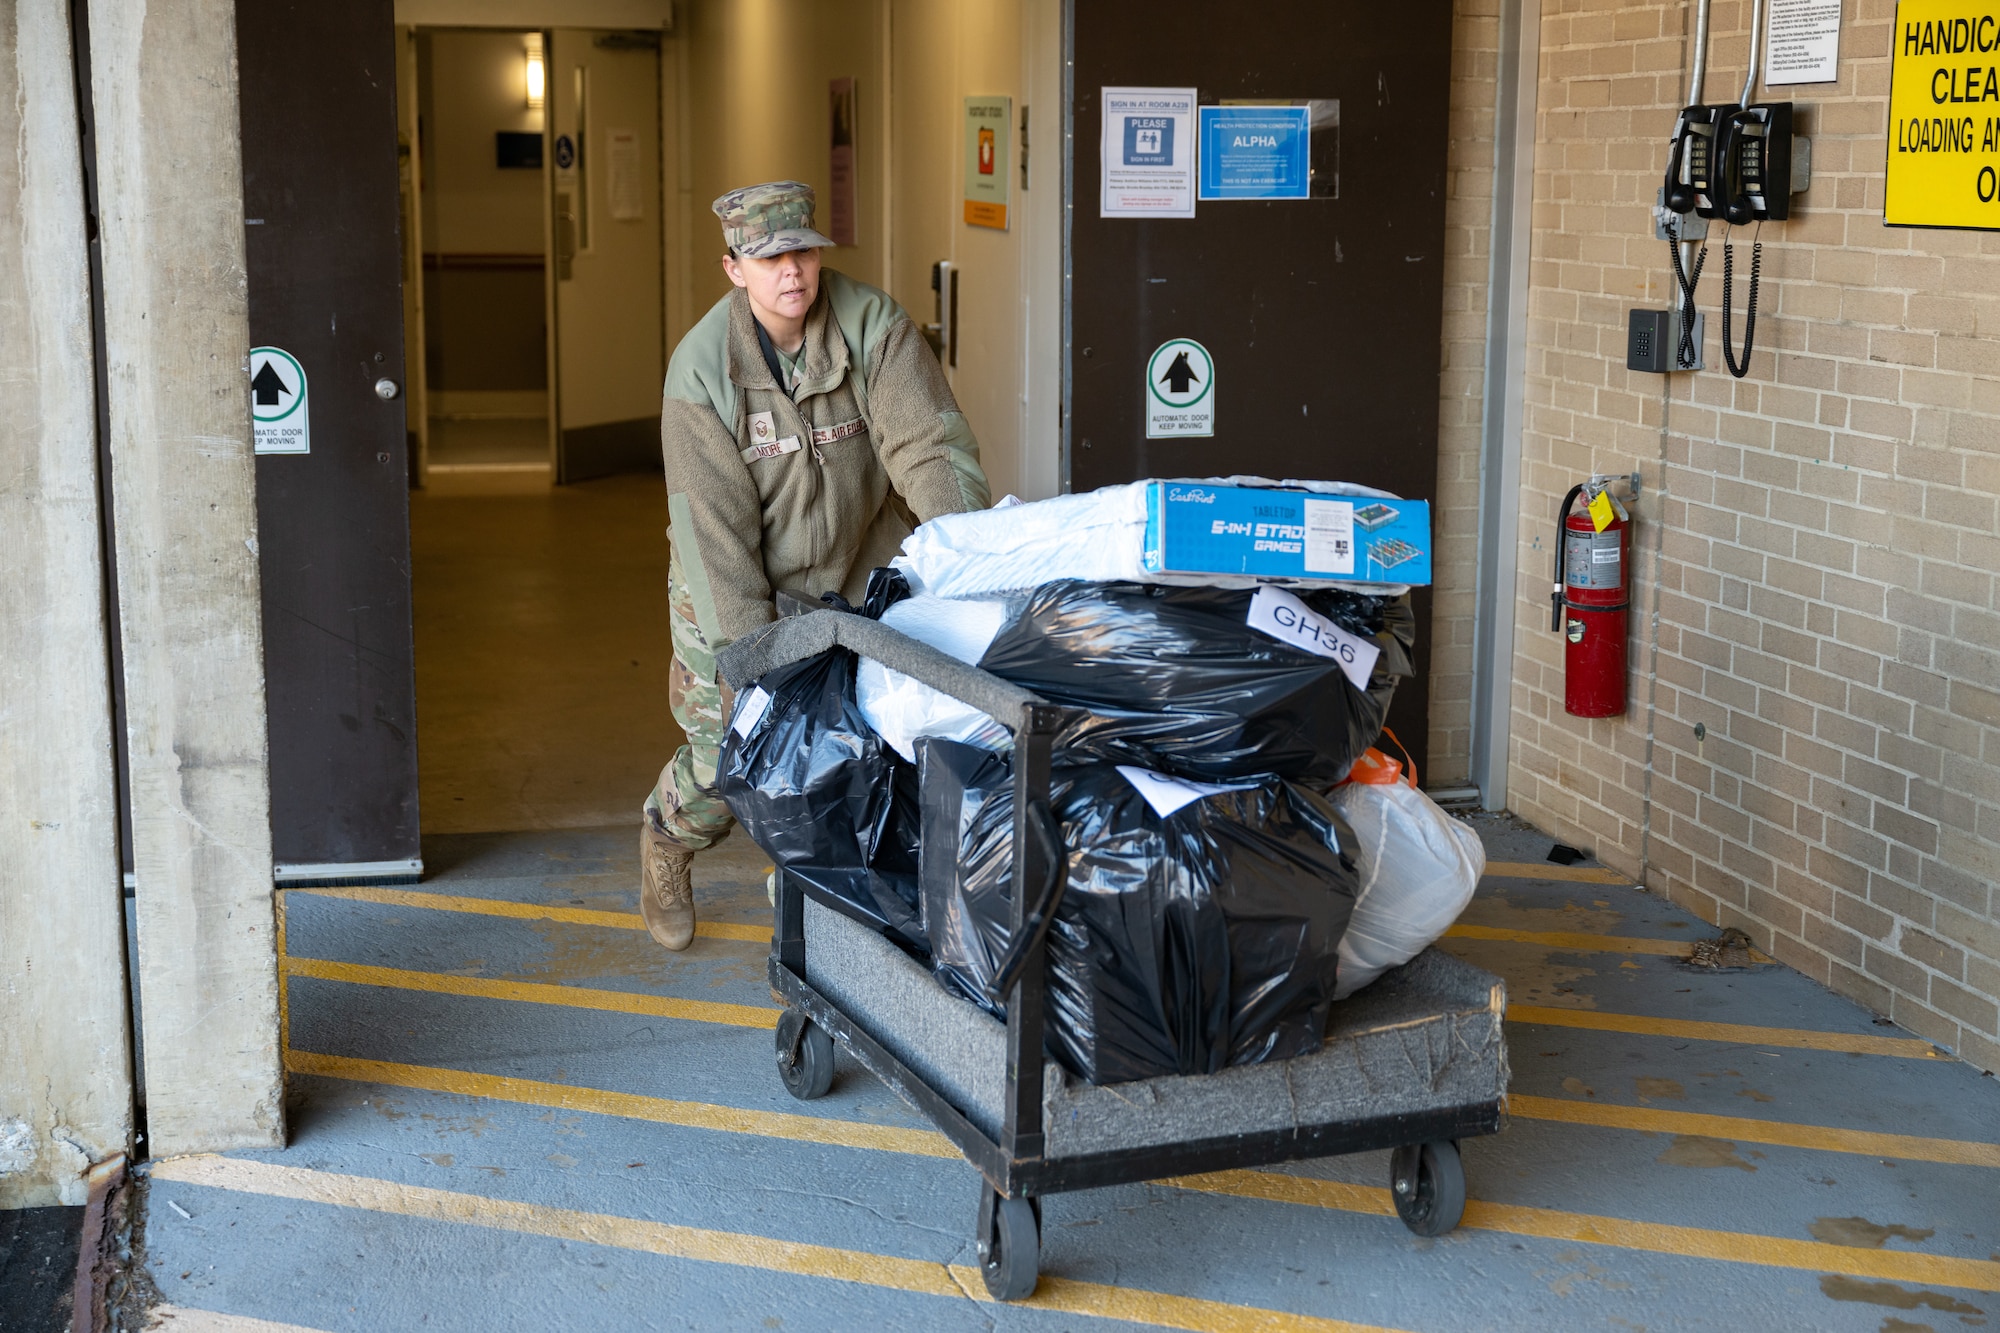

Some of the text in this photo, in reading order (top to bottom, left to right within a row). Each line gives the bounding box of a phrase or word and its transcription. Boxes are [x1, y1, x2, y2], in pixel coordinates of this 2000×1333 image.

[1904, 15, 2000, 56] HANDIC
[1131, 119, 1167, 128] PLEASE
[1233, 136, 1277, 147] ALPHA
[1898, 117, 2000, 154] LOADING A
[1977, 166, 2000, 203] O
[832, 426, 846, 440] AIR
[1169, 488, 1216, 504] EastPoint
[1253, 505, 1296, 519] TABLETOP
[1211, 520, 1305, 540] 5-IN-1 STAD
[1254, 540, 1302, 553] GAMES
[1273, 606, 1356, 664] GH36
